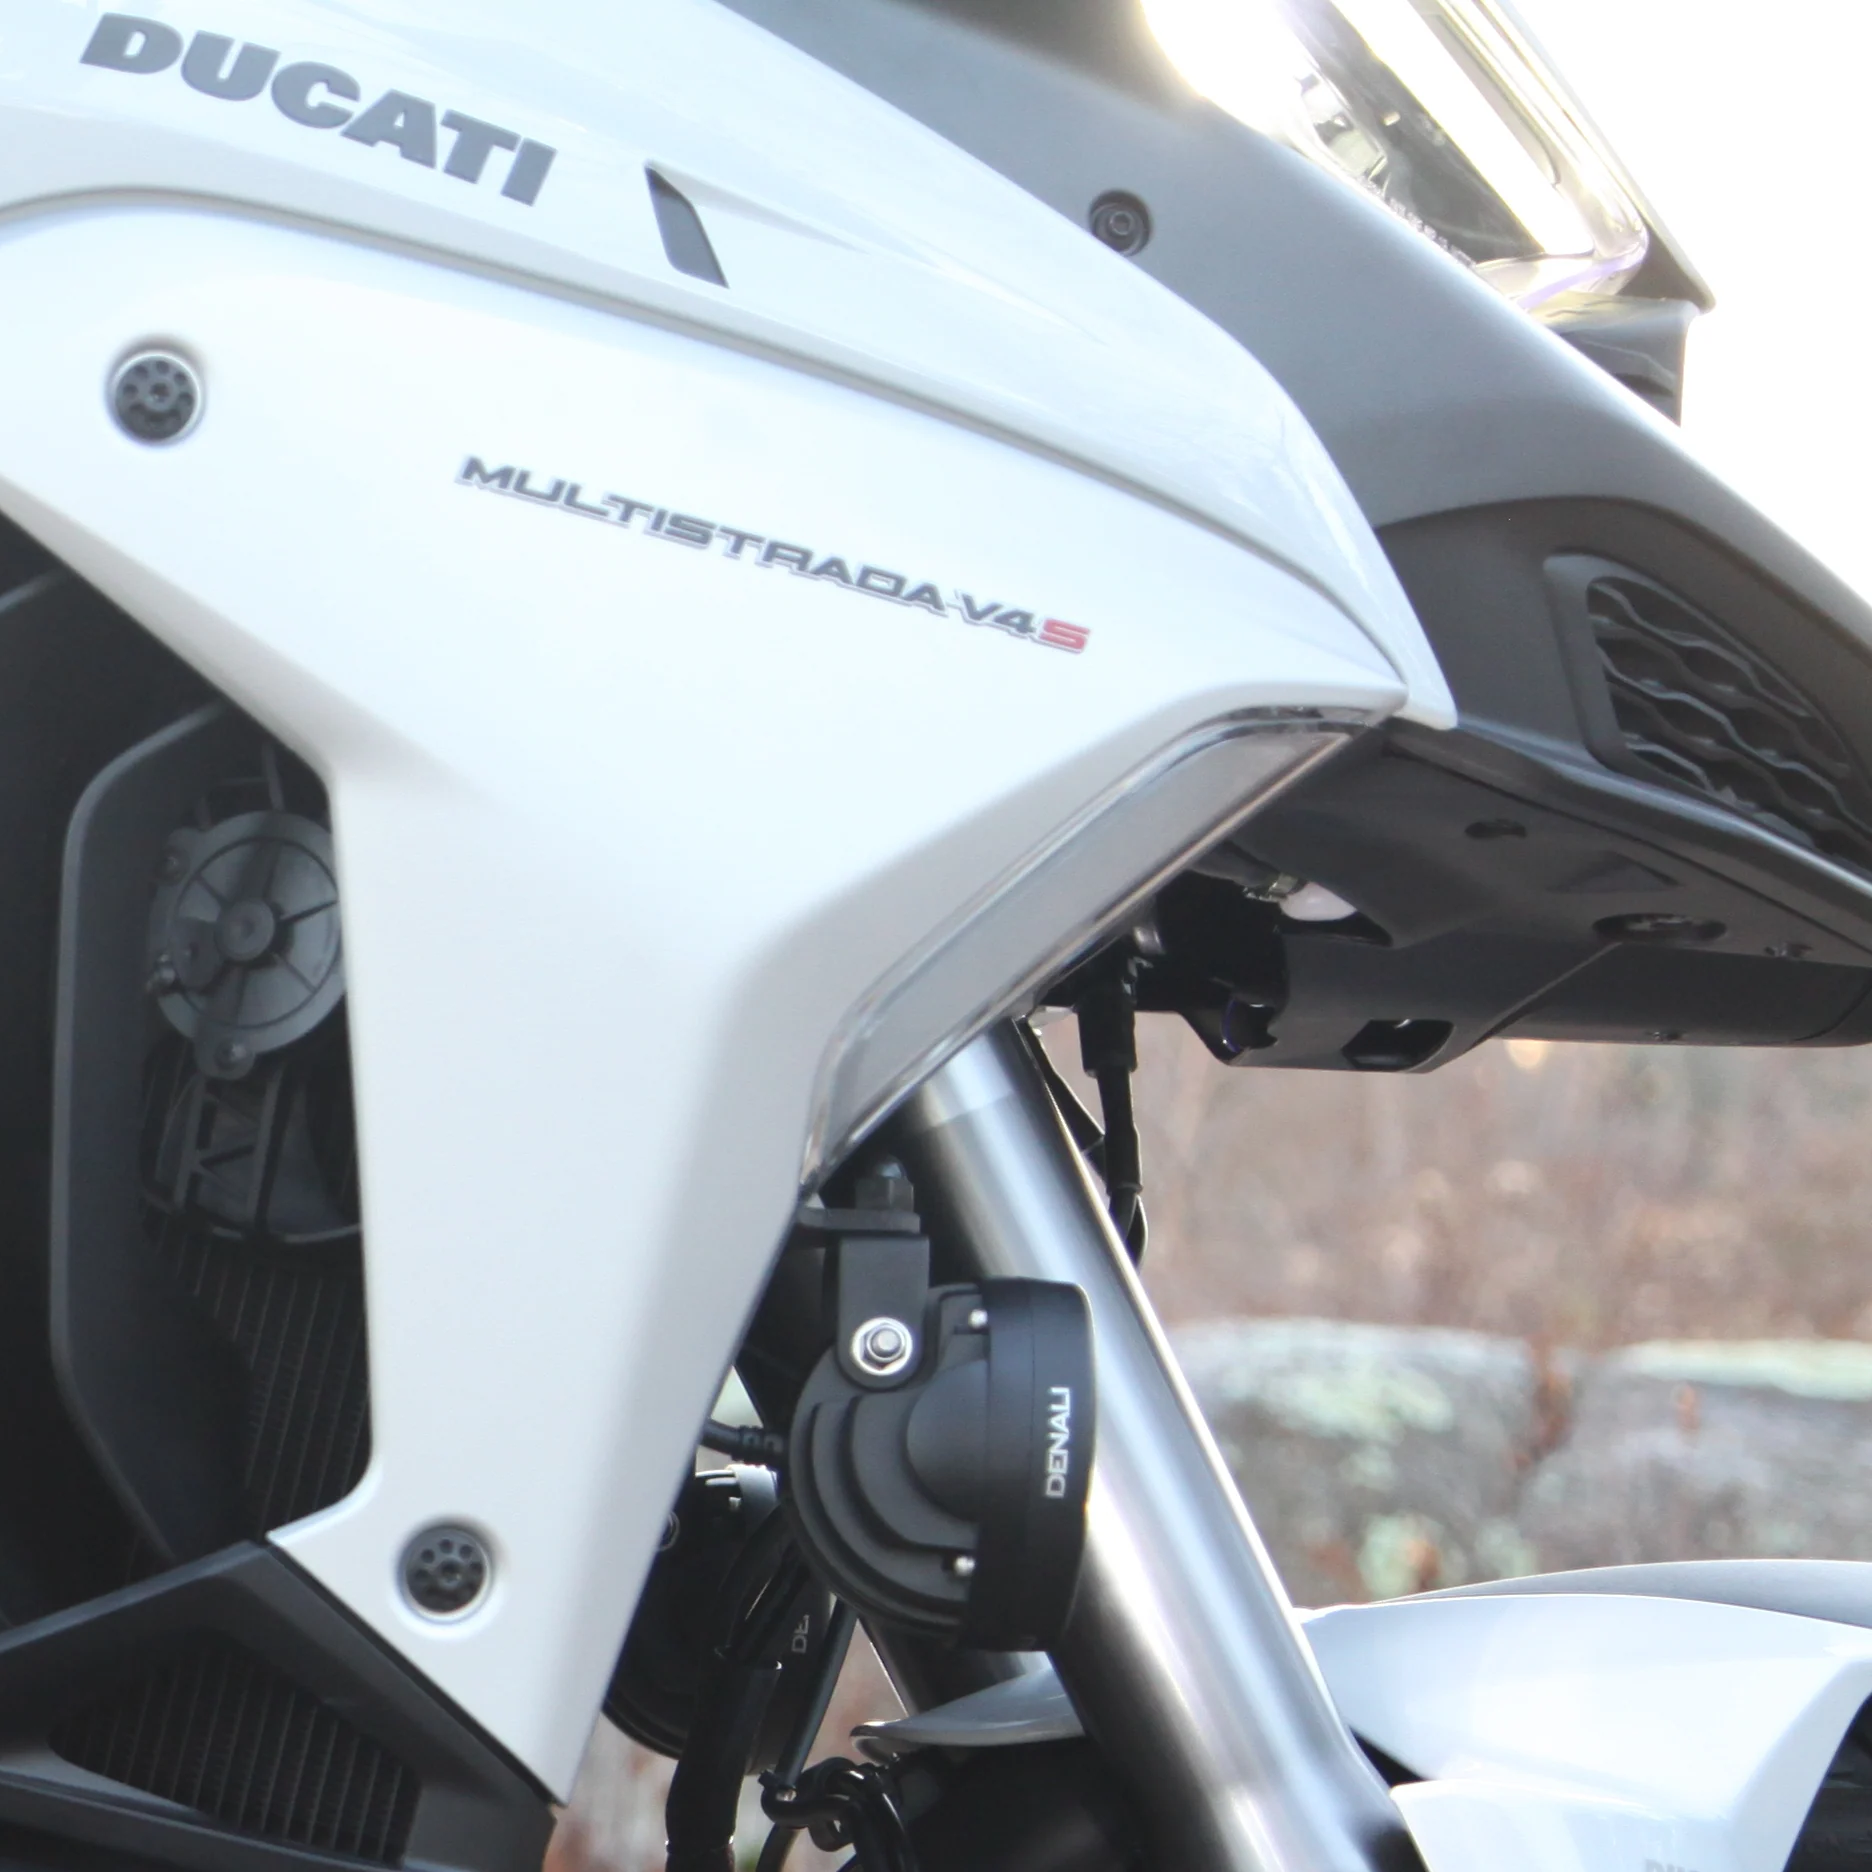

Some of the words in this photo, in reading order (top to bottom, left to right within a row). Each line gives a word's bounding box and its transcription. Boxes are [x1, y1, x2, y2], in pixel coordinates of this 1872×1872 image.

[81, 12, 556, 206] DUCATI
[459, 455, 946, 616] MULTISTRADA
[953, 590, 1091, 654] V4S
[1045, 1387, 1072, 1499] DENALI
